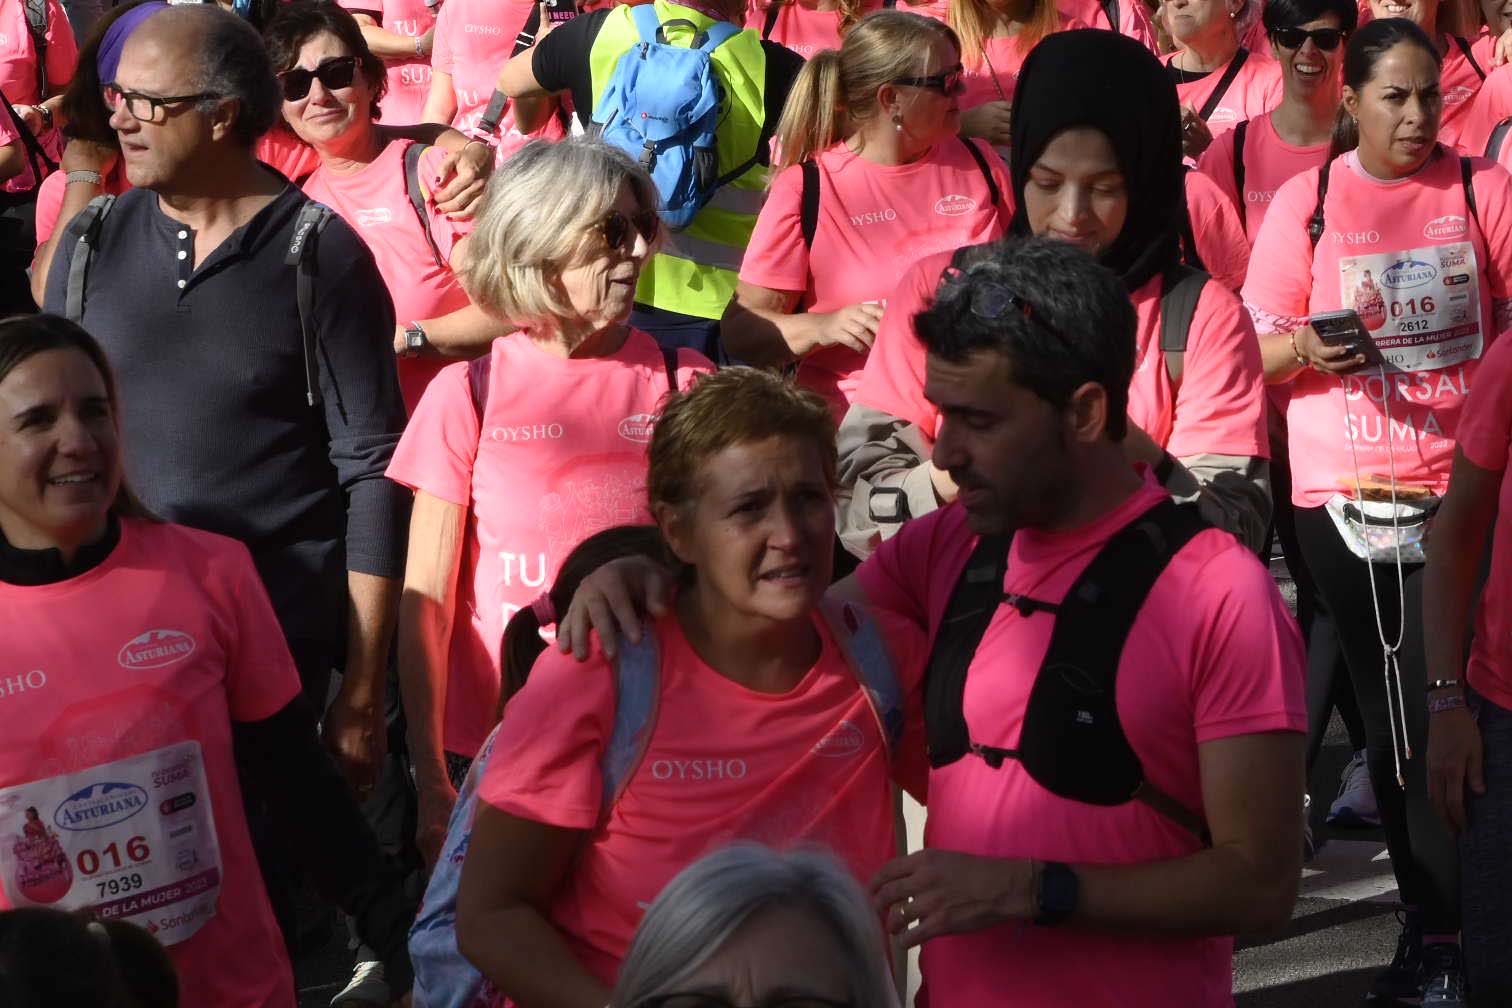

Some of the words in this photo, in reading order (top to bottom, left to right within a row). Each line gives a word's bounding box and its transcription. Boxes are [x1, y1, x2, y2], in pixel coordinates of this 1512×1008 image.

[553, 12, 576, 20] NEED
[393, 20, 418, 37] TU
[1385, 271, 1433, 285] ASTURIANA
[1391, 296, 1436, 317] 016
[1400, 320, 1429, 332] 2612
[1402, 337, 1413, 345] DE
[1345, 368, 1469, 402] DORSAL
[493, 423, 564, 442] OYSHO
[1344, 411, 1443, 443] SUMA
[498, 552, 547, 588] TU
[125, 641, 191, 666] ASTURIANA
[651, 758, 748, 780] OYSHO
[63, 795, 142, 827] ASTURIANA
[77, 835, 150, 876] 016
[96, 872, 144, 899] 7939
[102, 904, 121, 917] DE
[122, 900, 140, 912] LA
[141, 887, 181, 907] MUJER
